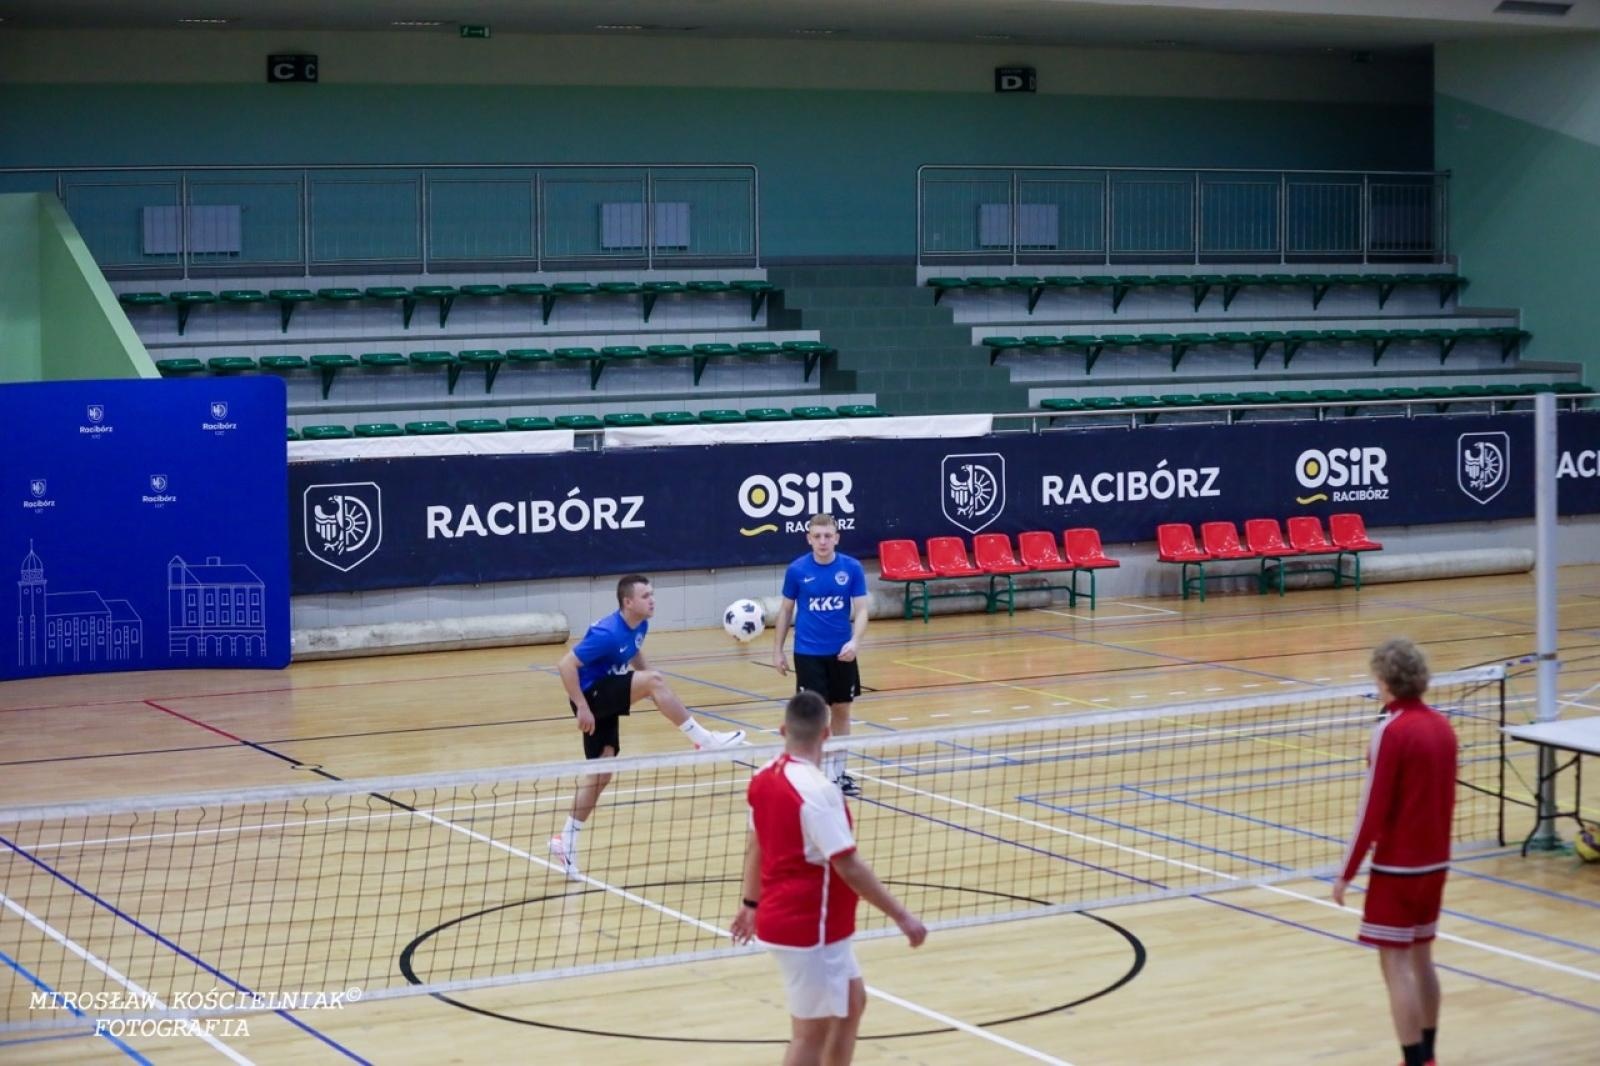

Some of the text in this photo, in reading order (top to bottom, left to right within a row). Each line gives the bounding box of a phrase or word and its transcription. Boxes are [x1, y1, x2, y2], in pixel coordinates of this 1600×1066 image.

[273, 63, 296, 80] C
[1001, 75, 1024, 90] D
[1042, 459, 1221, 506] RACIBÓRZ
[1333, 487, 1389, 502] RACIBÓRZ
[426, 486, 646, 539] RACIBÓRZ
[809, 595, 845, 612] KKS
